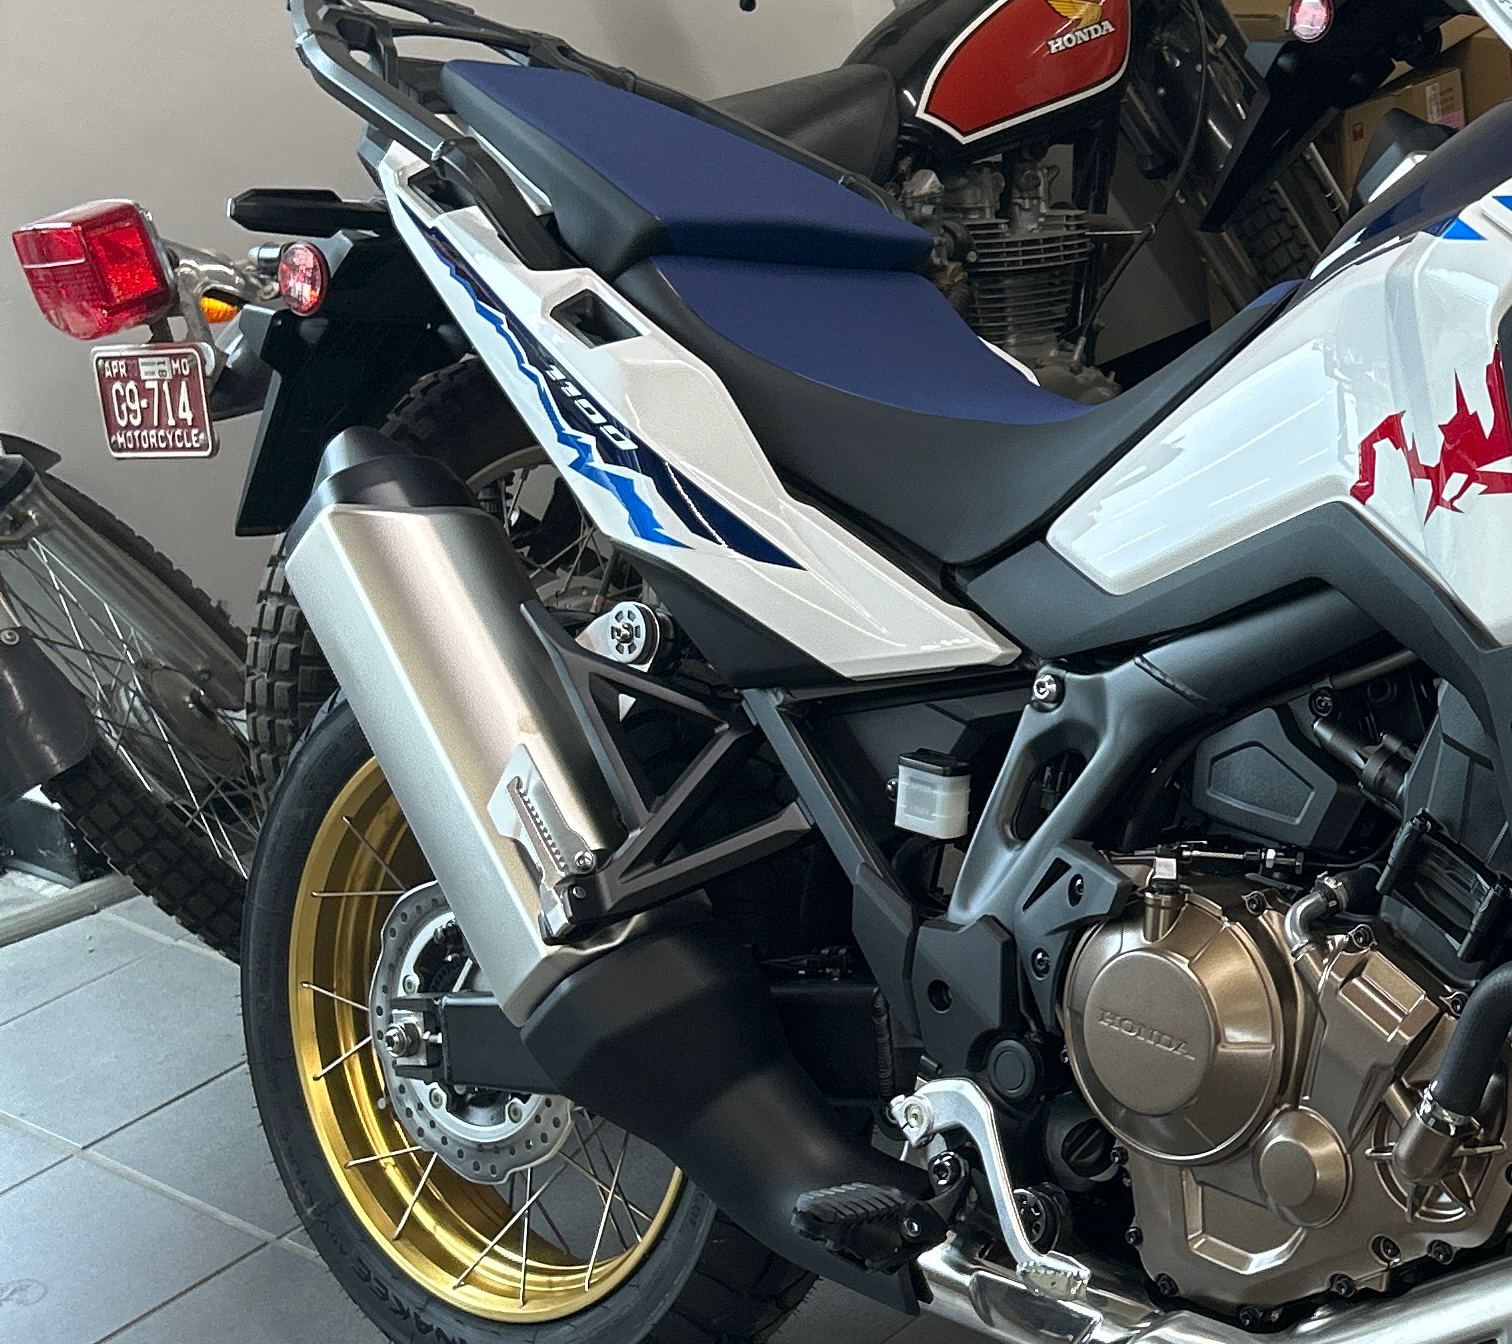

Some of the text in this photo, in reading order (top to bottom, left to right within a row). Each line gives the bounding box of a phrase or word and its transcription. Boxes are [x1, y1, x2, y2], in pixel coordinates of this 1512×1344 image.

[1046, 20, 1116, 54] HONDA
[104, 358, 191, 378] APR MO
[111, 379, 194, 427] G9-714
[544, 363, 640, 451] 1100
[117, 428, 201, 449] MOTORCYCLE
[1098, 1007, 1195, 1061] HONDA
